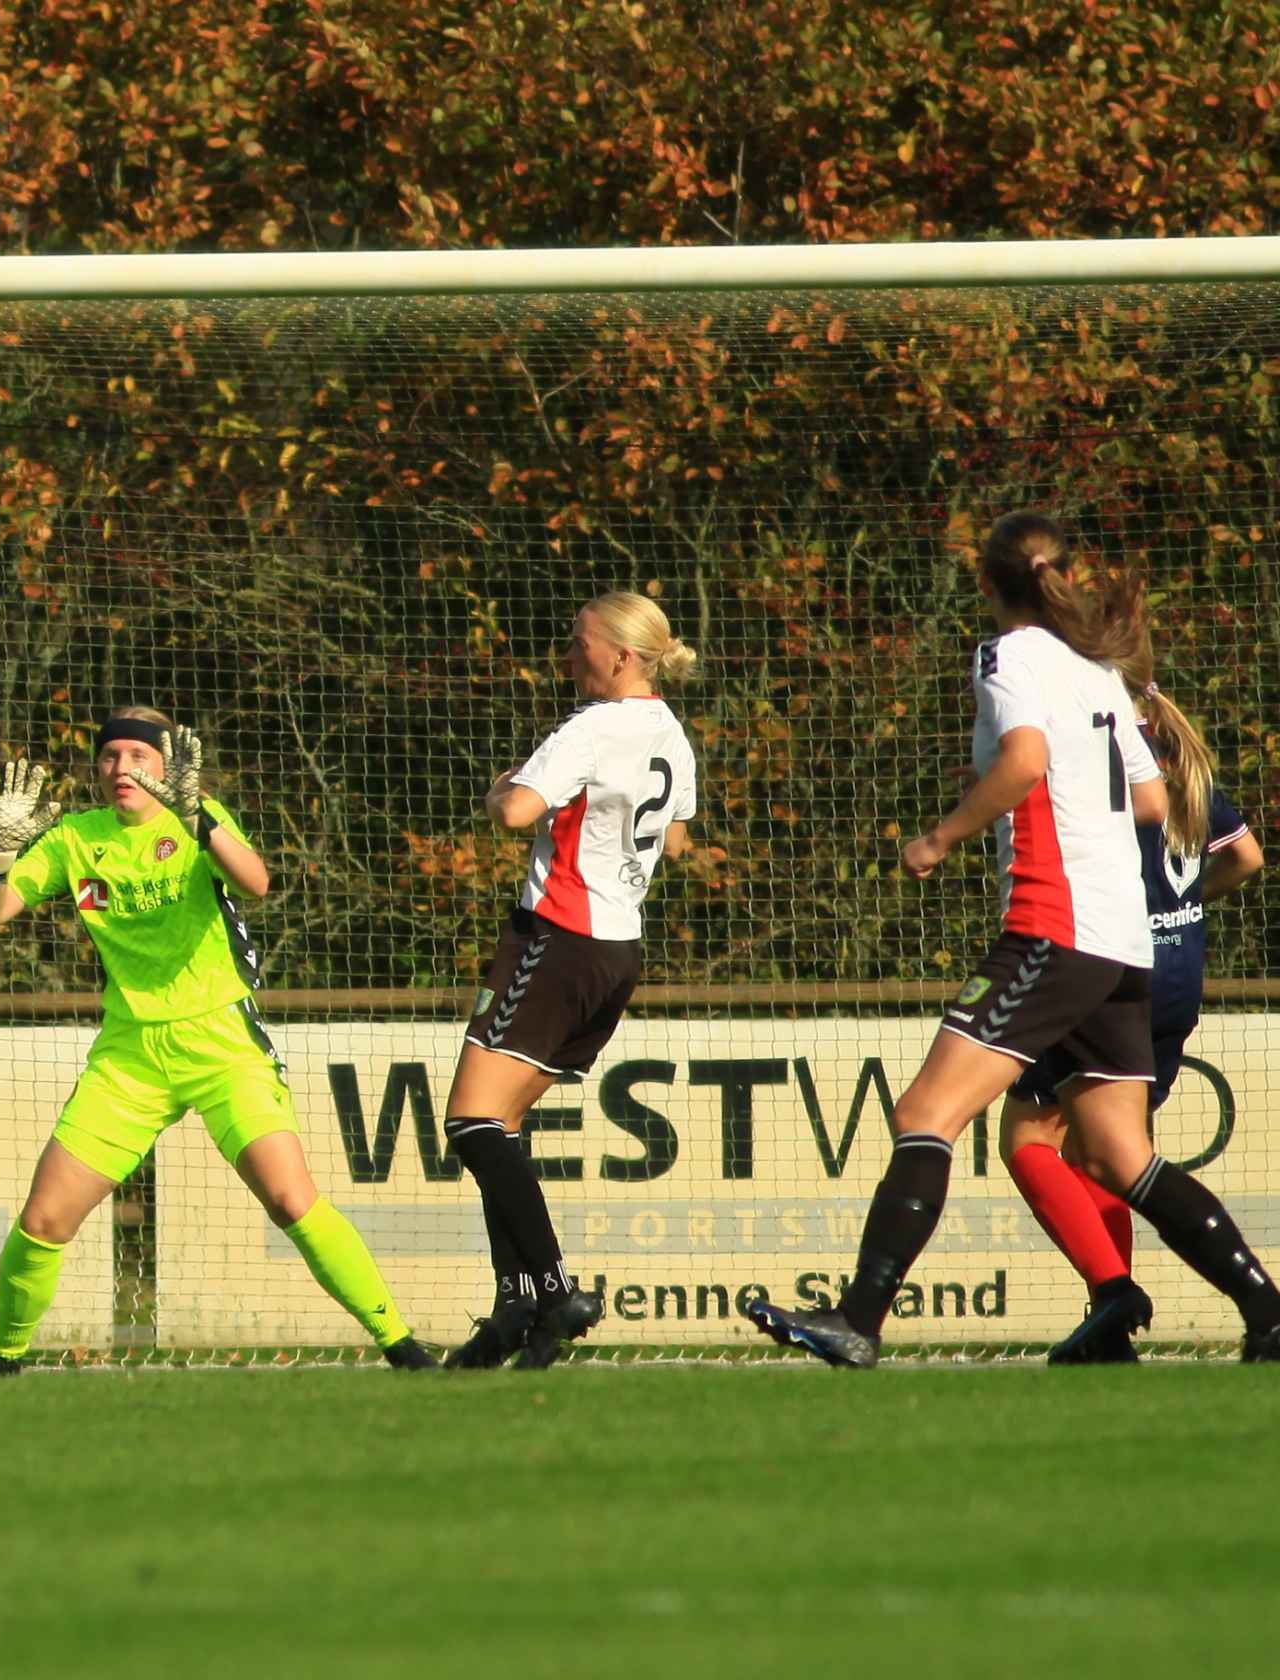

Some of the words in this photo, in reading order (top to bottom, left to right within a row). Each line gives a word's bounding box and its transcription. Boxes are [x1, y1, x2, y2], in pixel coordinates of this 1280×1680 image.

[633, 756, 673, 852] 2
[327, 1055, 1236, 1184] WESTWID
[548, 1206, 1024, 1250] PORTSWAR
[794, 1268, 1008, 1319] Sand
